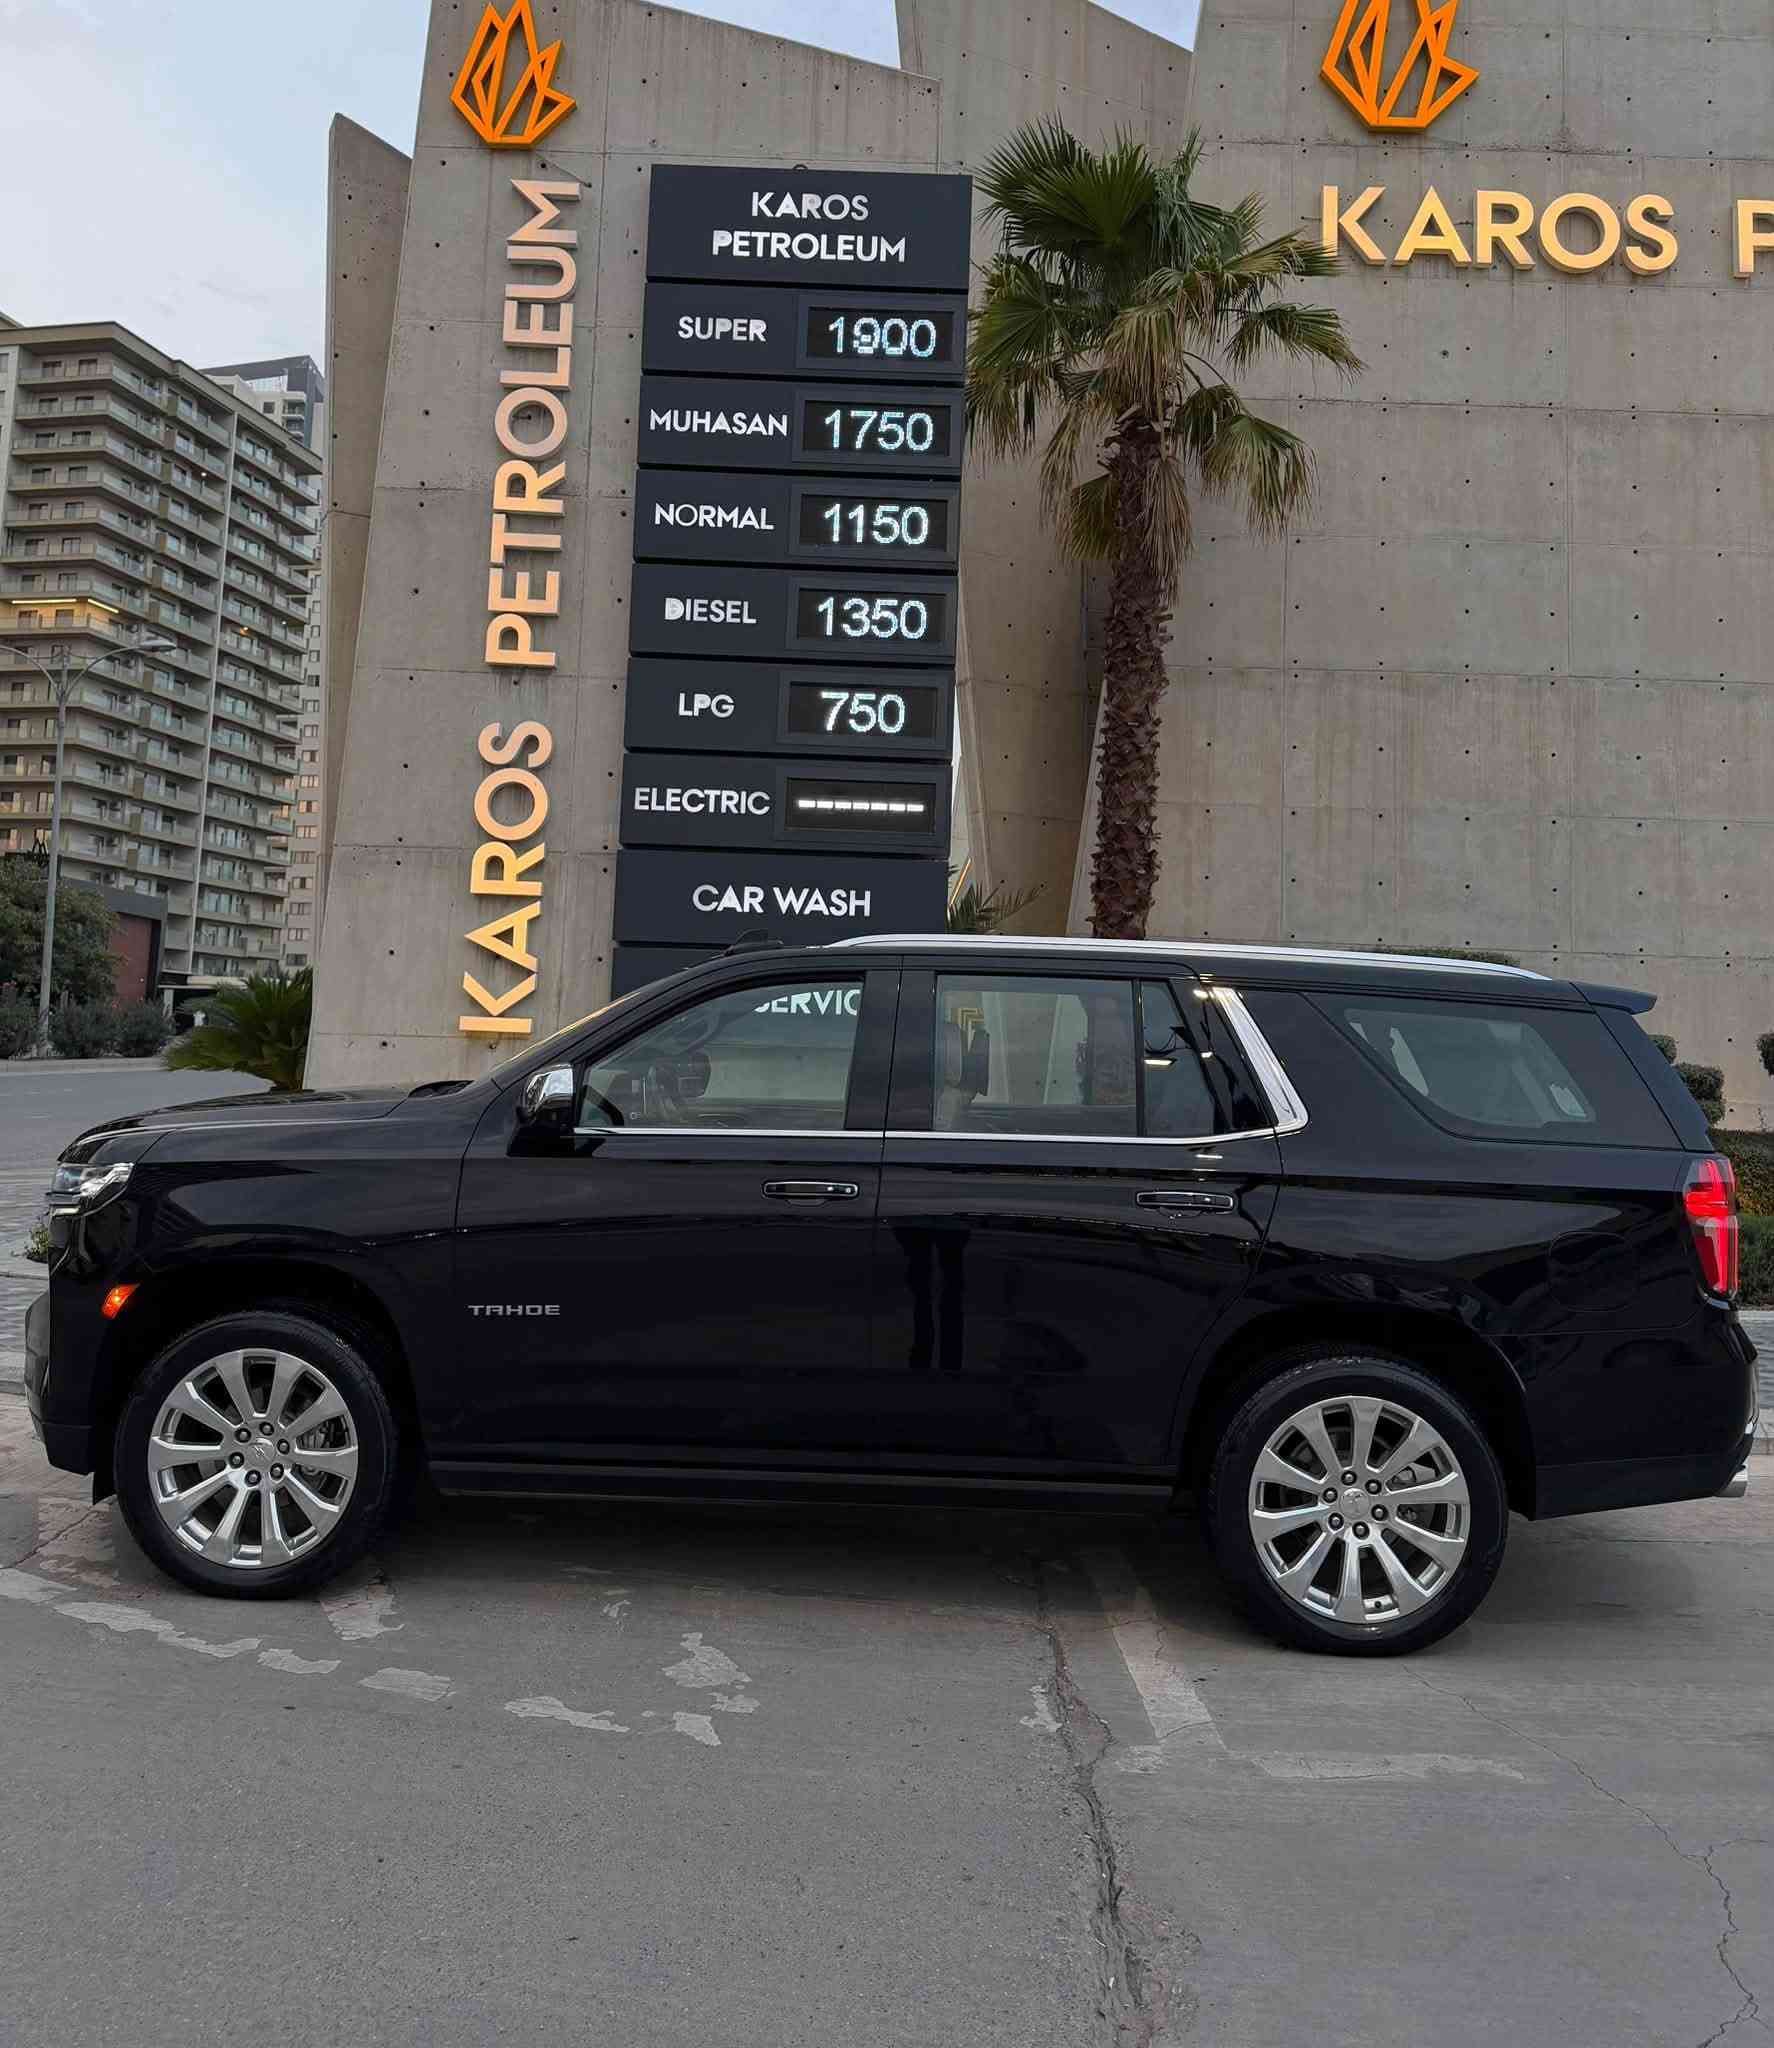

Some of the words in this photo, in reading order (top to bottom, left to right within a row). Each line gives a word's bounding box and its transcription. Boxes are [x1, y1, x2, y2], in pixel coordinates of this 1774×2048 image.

[751, 191, 869, 221] KAROS
[711, 229, 906, 262] PETROLEUM
[1320, 184, 1679, 276] KAROS
[677, 315, 768, 342] SUPER
[828, 315, 938, 358] 1900
[485, 178, 581, 669] PETROLEUM
[649, 408, 788, 437] MUHASAN
[824, 408, 934, 451] 1750
[654, 502, 775, 531] NORMAL
[823, 502, 930, 545] 1150
[664, 597, 757, 625] DIESEL
[816, 596, 928, 640] 1350
[678, 692, 736, 718] LPG
[820, 690, 906, 734] 750
[633, 787, 771, 817] ELECTRIC
[458, 719, 553, 1035] KAROS
[692, 884, 765, 913] CAR
[772, 886, 872, 917] WASH
[467, 1304, 561, 1316] TAHOE
